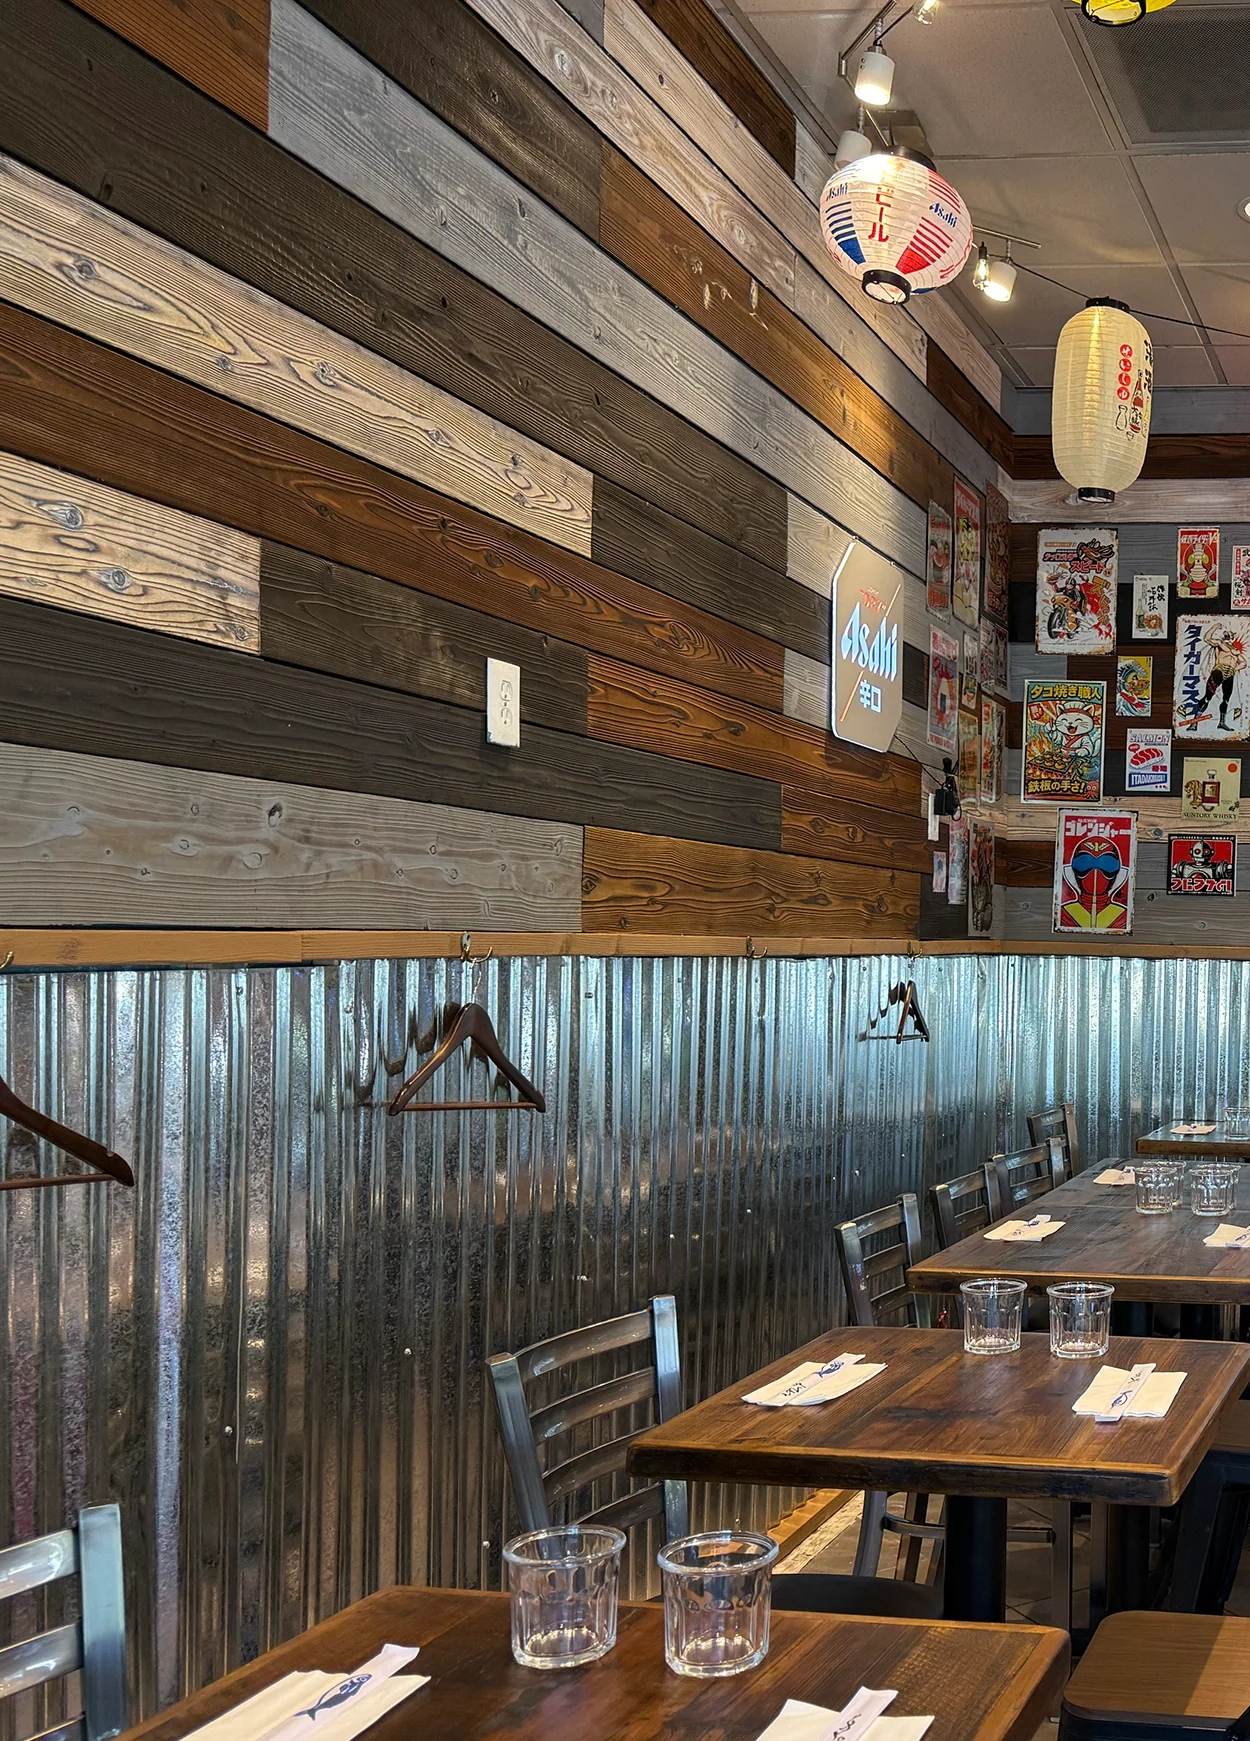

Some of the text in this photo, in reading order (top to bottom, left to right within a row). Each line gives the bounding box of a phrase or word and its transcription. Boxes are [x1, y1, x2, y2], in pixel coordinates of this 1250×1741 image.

[826, 182, 848, 201] Asahi
[929, 202, 957, 228] Asahi
[1117, 344, 1133, 400] せいしゅ
[841, 602, 898, 682] Asahi
[1182, 624, 1203, 717] タイガーマスク
[860, 680, 882, 713] 辛口
[1031, 685, 1102, 699] タコ焼き職人
[1065, 820, 1132, 837] ゴレンジャー
[1212, 812, 1237, 820] WHISKY
